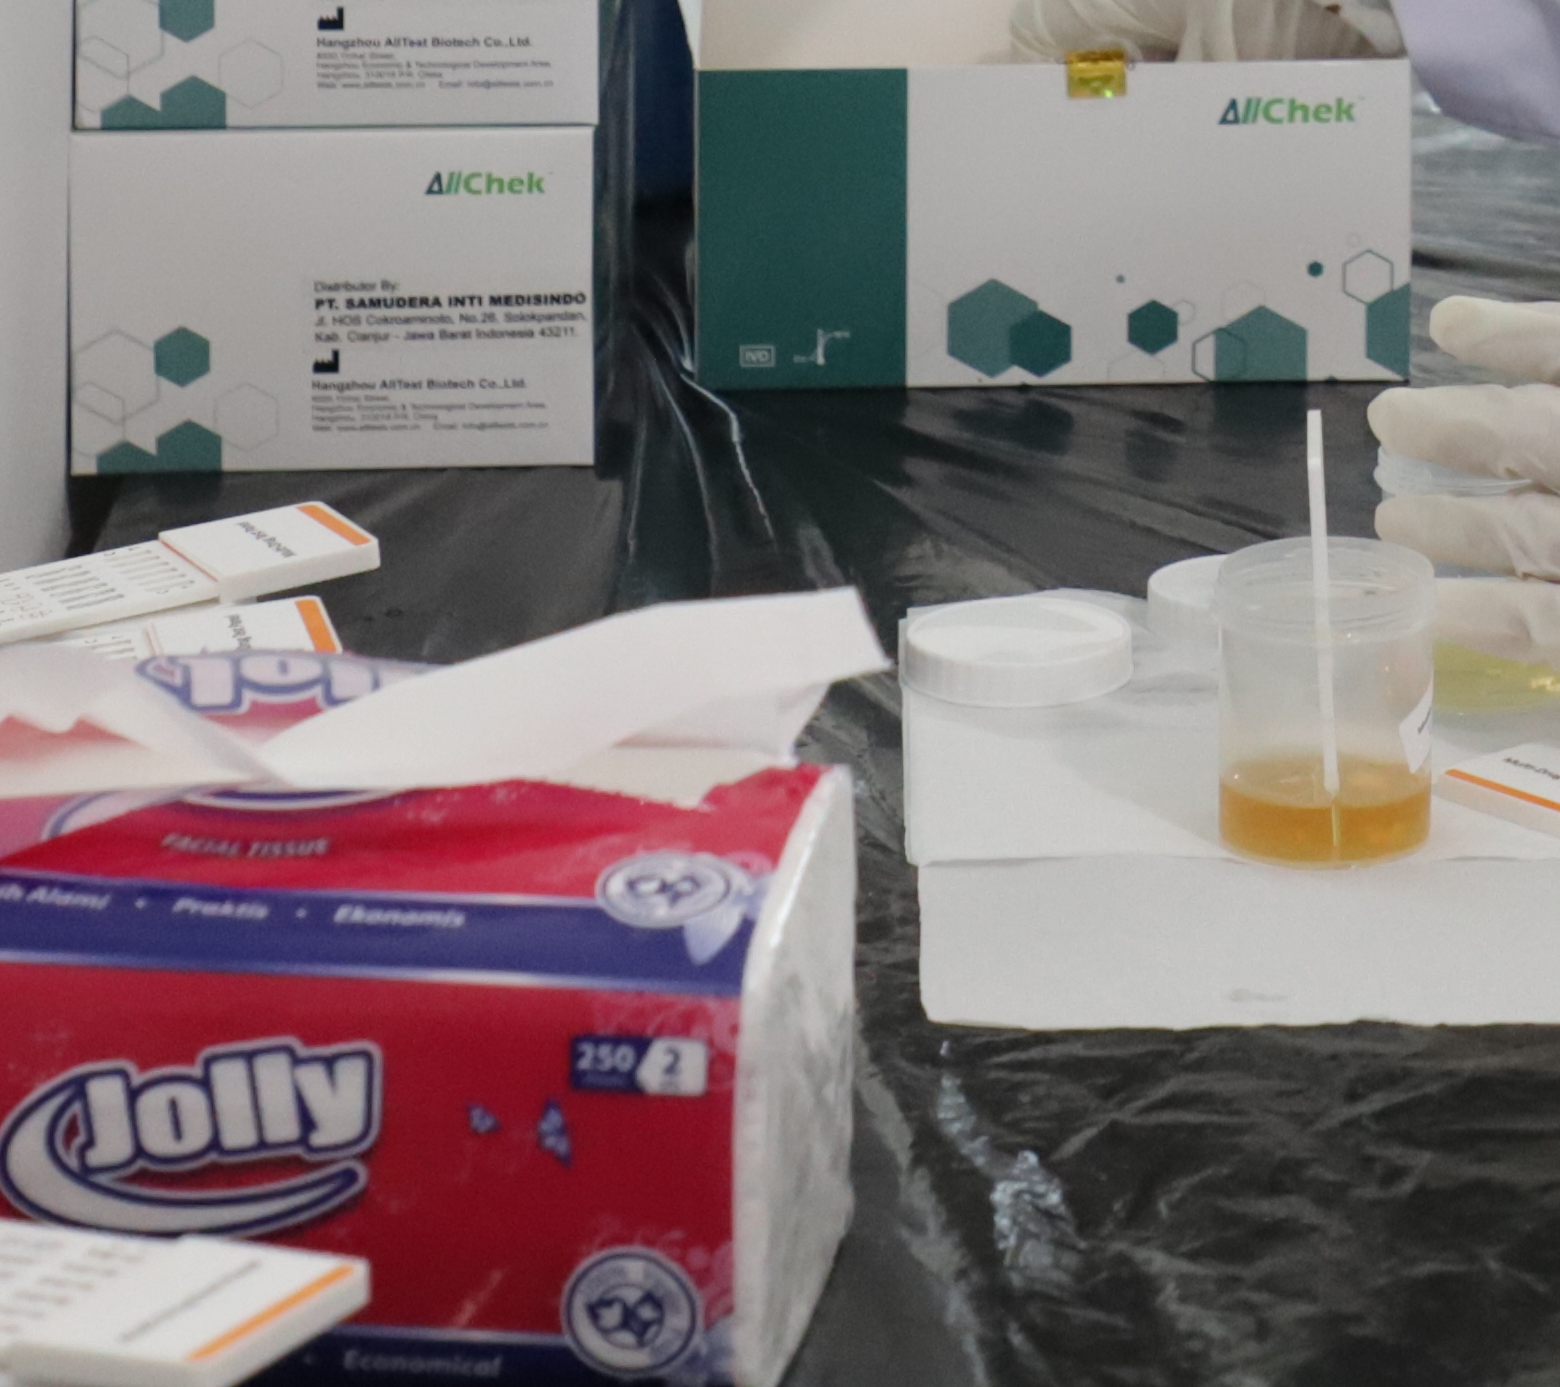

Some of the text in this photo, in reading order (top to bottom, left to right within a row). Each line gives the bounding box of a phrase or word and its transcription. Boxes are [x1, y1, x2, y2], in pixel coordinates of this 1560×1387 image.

[1218, 97, 1355, 125] AllChek
[315, 293, 586, 310] PT. SAMUDERA INTI MEDISINDO
[404, 329, 434, 341] Jawa
[440, 329, 471, 340] Barat
[161, 832, 329, 858] FACIAL TISSUE
[25, 888, 111, 911] Alami
[171, 897, 269, 920] Praktis
[334, 903, 466, 928] Ekonomis
[575, 1041, 682, 1075] 250 2
[79, 1050, 373, 1172] Jolly
[343, 1349, 502, 1377] Economical
